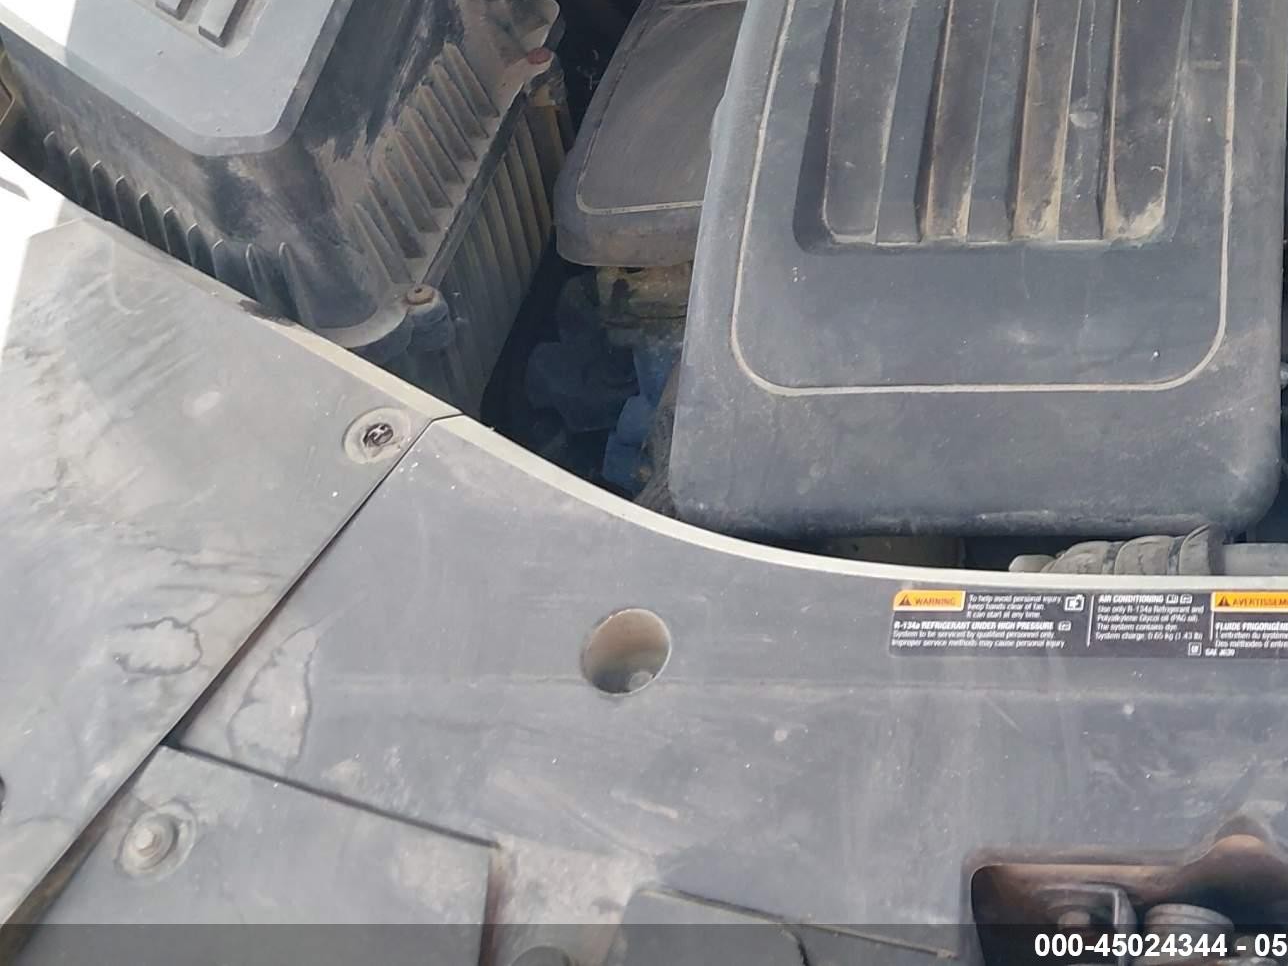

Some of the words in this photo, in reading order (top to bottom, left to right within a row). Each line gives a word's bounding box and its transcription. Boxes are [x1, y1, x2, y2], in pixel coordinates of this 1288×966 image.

[978, 595, 992, 603] help
[1013, 595, 1041, 603] personal
[1099, 595, 1112, 603] AIR
[1113, 595, 1164, 603] CONDITIONING
[1112, 605, 1126, 614] only
[921, 621, 969, 629] REFRIGERANT
[971, 621, 996, 629] UNDER
[998, 621, 1015, 629] HIGH
[1017, 621, 1054, 630] PRESSURE
[1110, 624, 1134, 632] system
[1215, 622, 1240, 630] FLUIDE
[1016, 640, 1044, 648] personal
